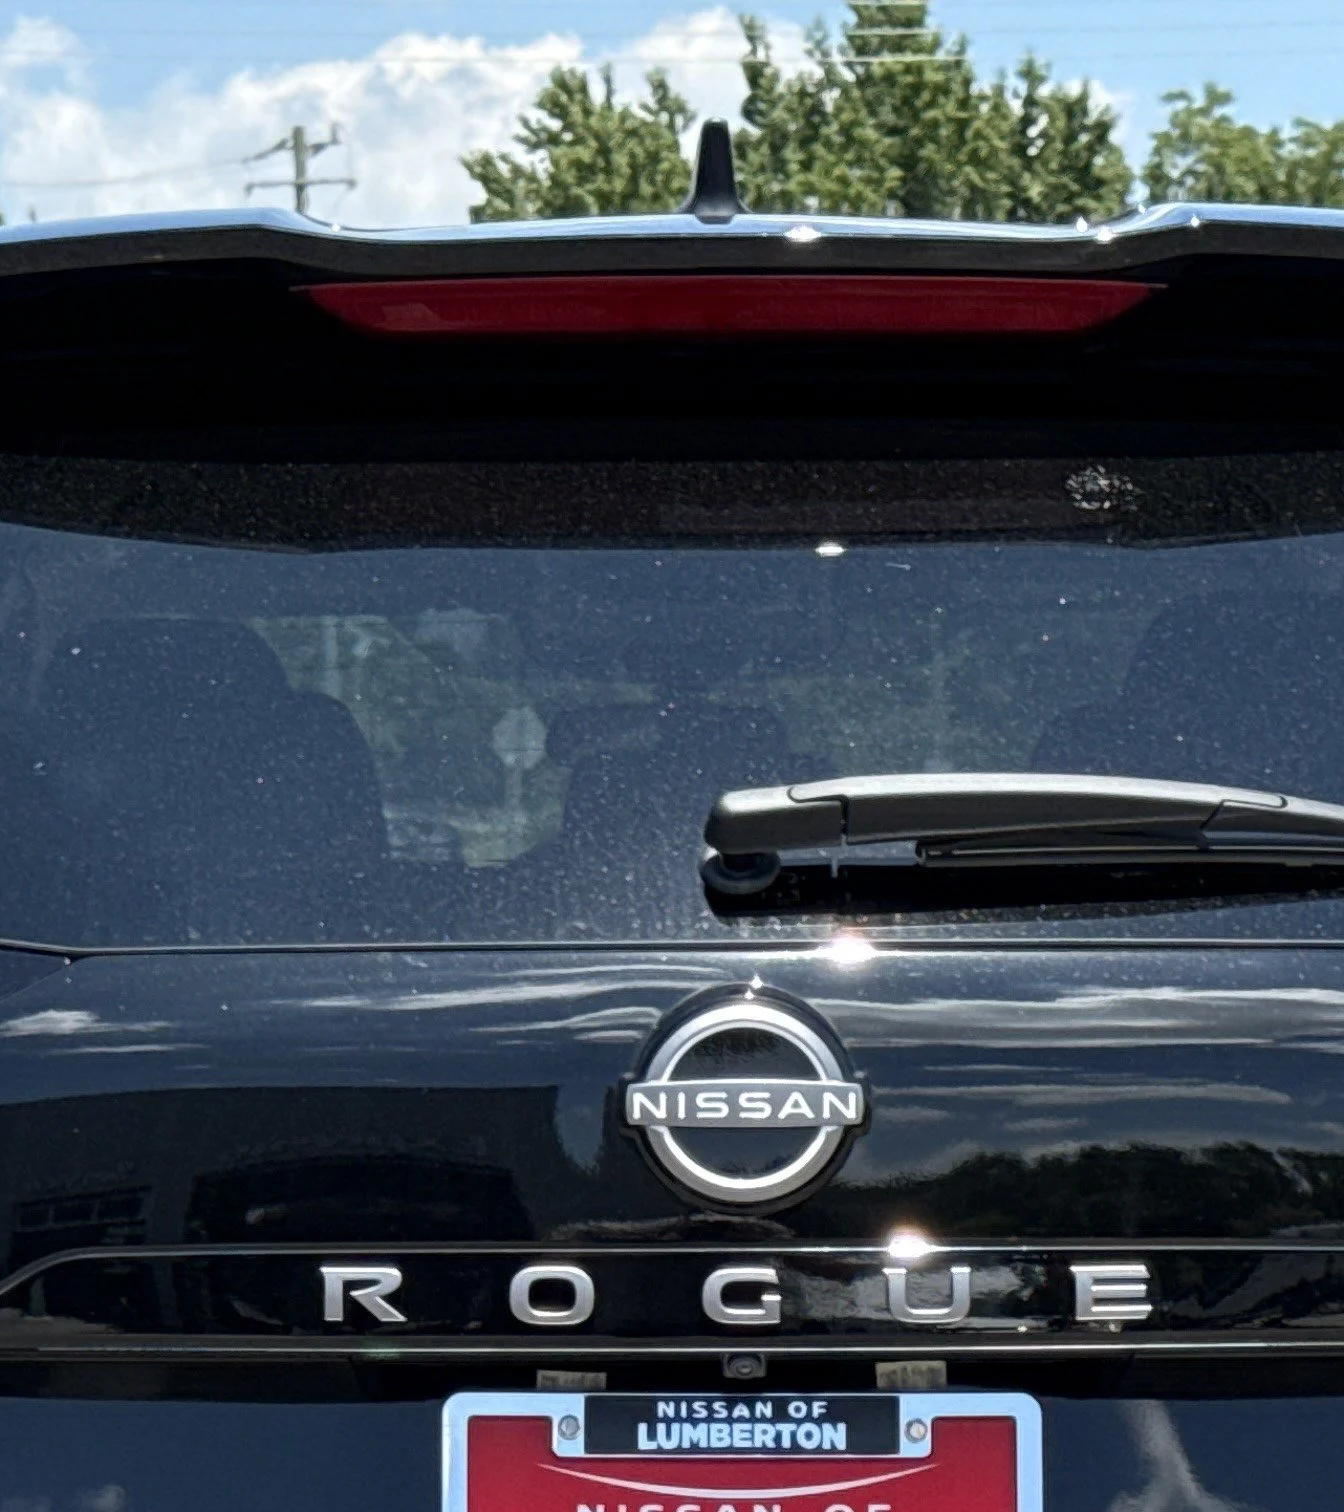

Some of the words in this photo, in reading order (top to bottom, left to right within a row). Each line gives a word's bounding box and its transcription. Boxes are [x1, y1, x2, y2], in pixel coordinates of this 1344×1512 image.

[632, 1091, 857, 1120] NISSAN
[320, 1263, 1154, 1326] ROGUE
[657, 1401, 773, 1419] NISSAN
[787, 1401, 828, 1419] OF
[637, 1422, 847, 1451] LUMBERTON
